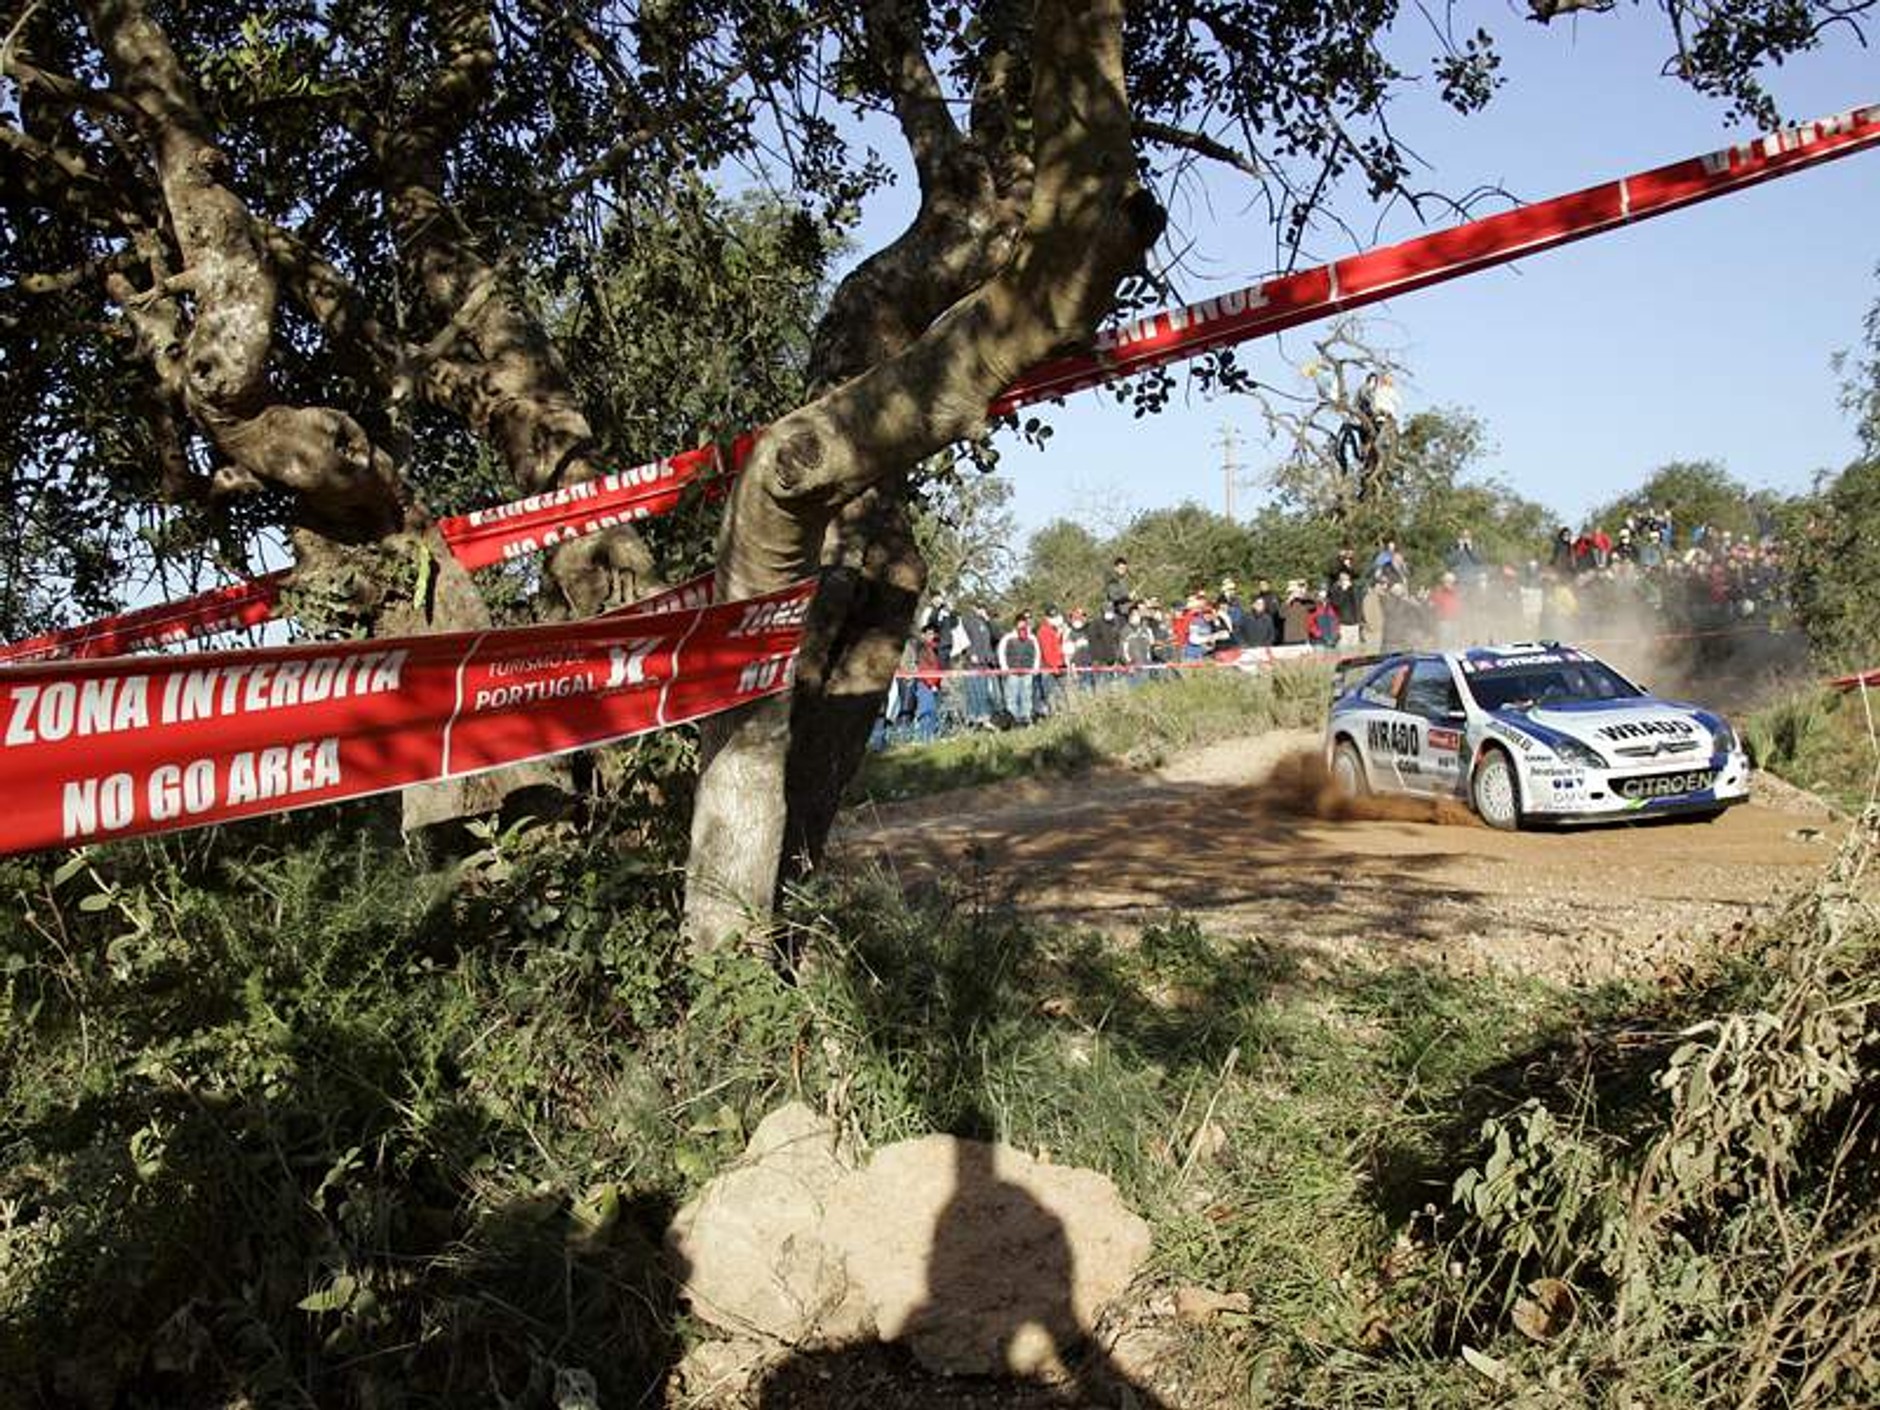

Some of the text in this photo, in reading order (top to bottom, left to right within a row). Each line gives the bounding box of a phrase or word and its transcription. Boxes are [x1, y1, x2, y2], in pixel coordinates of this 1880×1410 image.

[5, 650, 409, 747] ZONA INTERDITA
[474, 671, 600, 712] PORTUGAL
[62, 737, 341, 838] NO GO AREA
